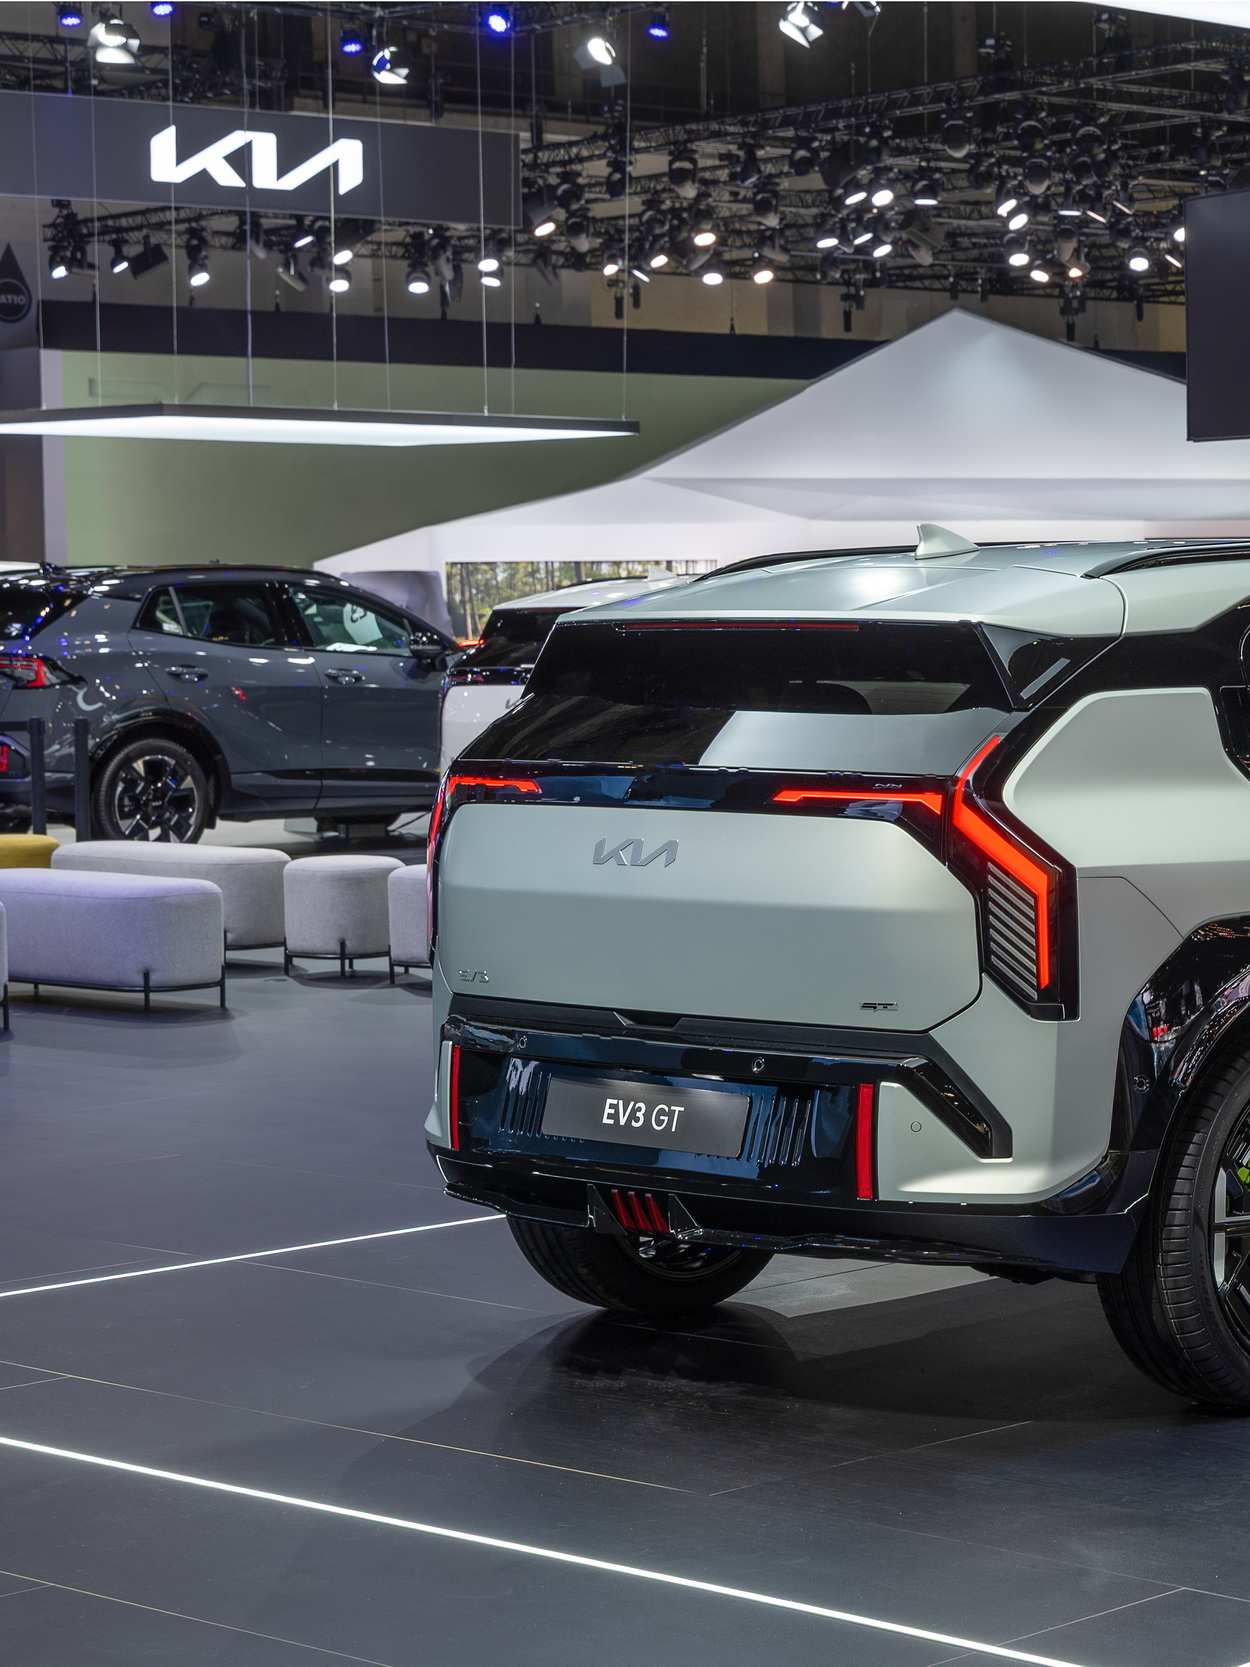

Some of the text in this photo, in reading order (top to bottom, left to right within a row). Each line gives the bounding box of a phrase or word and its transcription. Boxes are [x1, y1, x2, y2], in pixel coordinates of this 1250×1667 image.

[150, 124, 364, 196] KIA
[592, 836, 679, 868] KIA
[602, 1098, 685, 1132] EV3 GT
